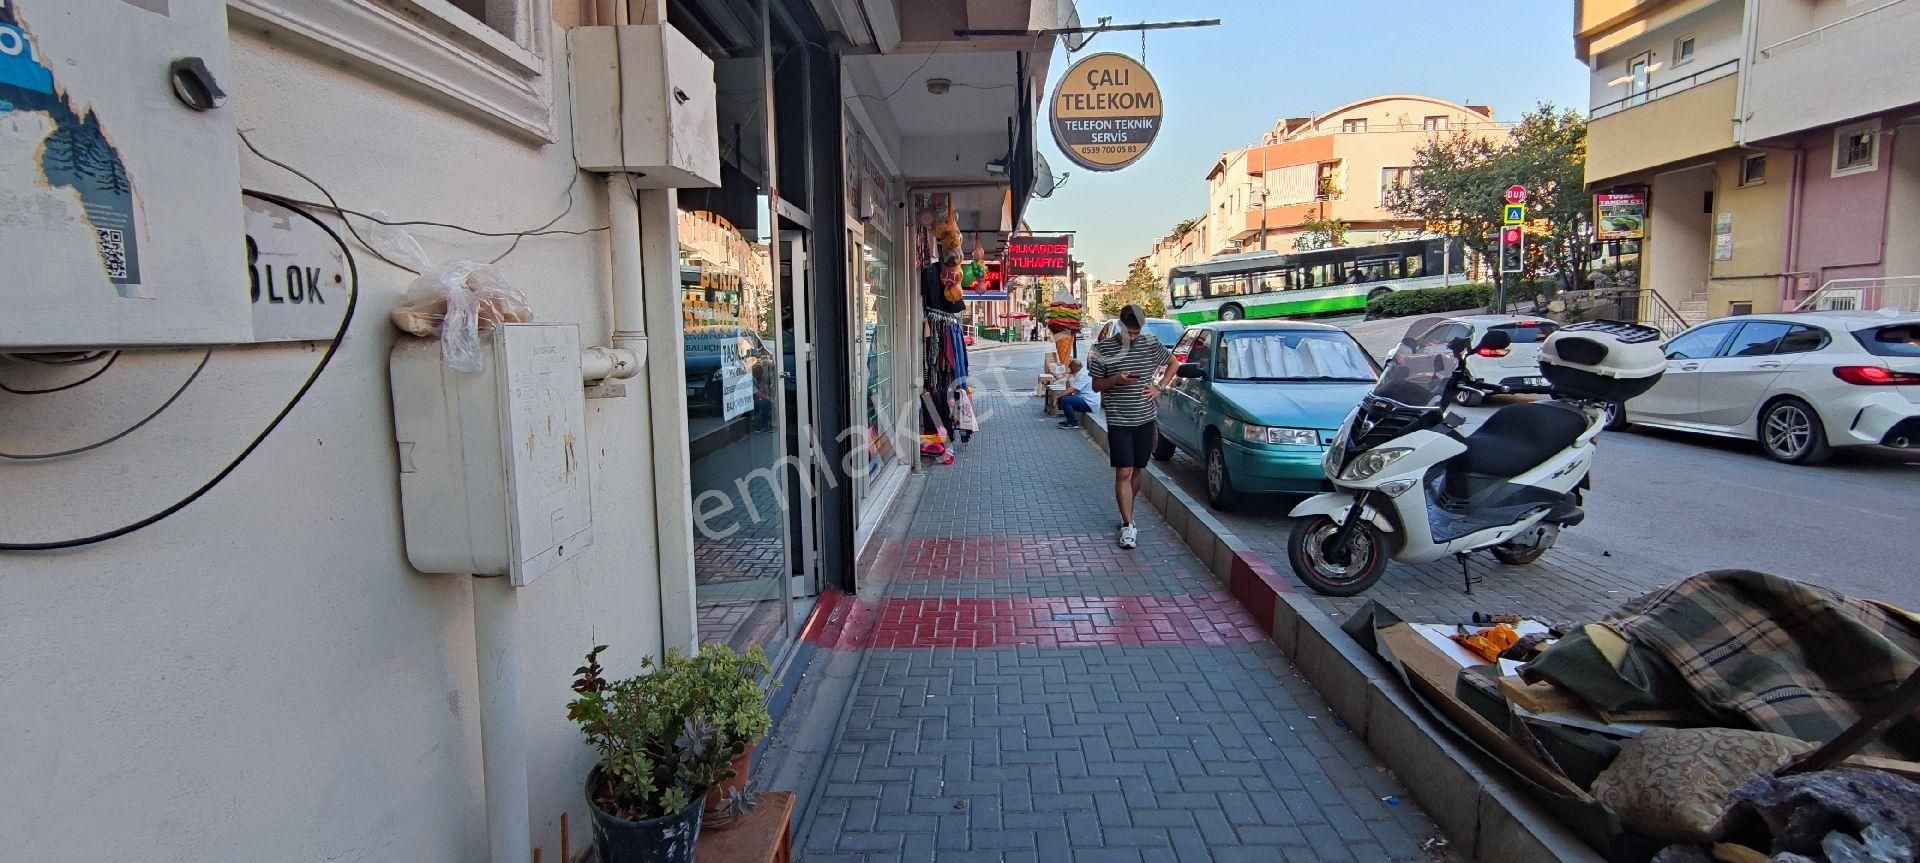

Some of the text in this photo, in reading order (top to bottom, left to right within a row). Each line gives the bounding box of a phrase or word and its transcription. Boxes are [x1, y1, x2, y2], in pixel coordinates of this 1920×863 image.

[1087, 68, 1129, 90] ÇALI
[1062, 92, 1154, 110] TELEKOM
[1065, 117, 1153, 131] TELEFON TEKNİK
[1091, 130, 1128, 143] SERVİS
[1081, 146, 1100, 154] 0539
[1127, 145, 1137, 153] 83
[1507, 190, 1526, 199] DUR
